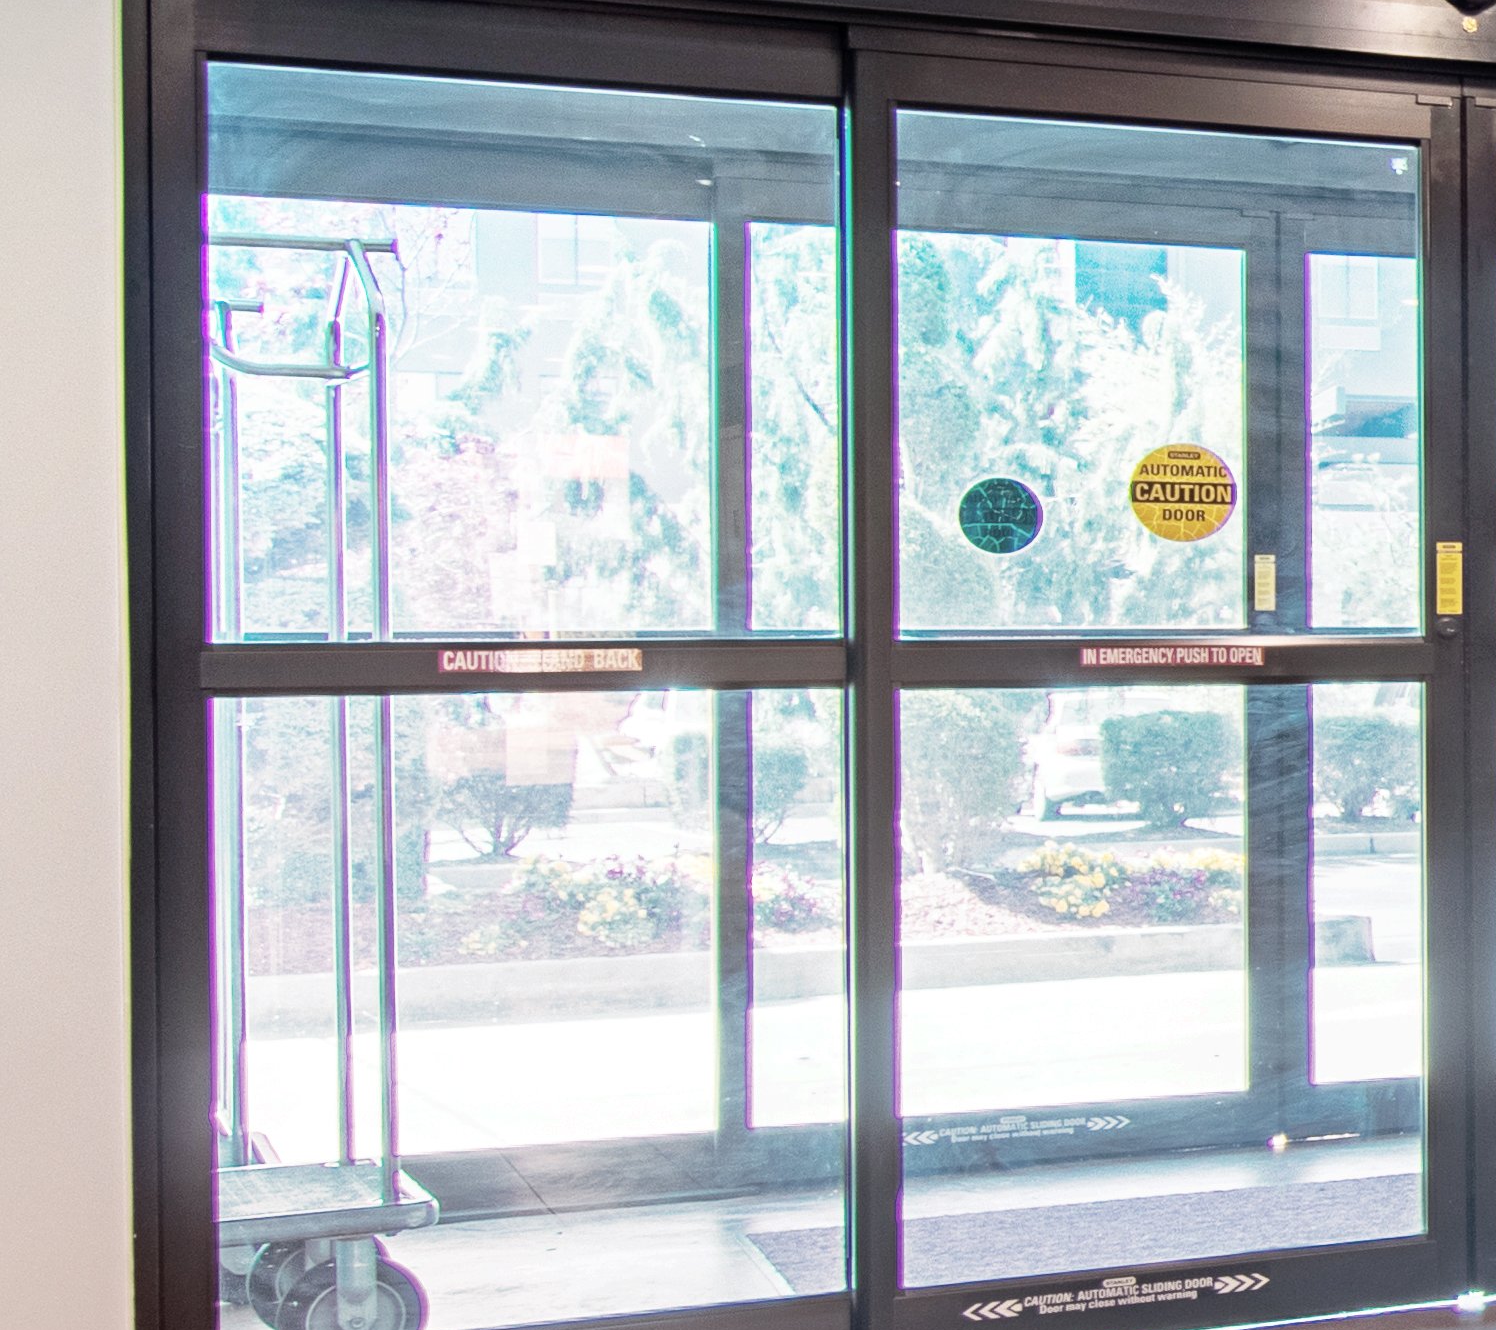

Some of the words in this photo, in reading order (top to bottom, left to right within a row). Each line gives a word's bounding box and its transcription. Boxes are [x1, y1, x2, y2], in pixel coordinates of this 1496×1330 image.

[1139, 464, 1228, 478] AUTOMATIC
[1135, 483, 1232, 502] CAUTION
[1163, 509, 1205, 521] DOOR
[593, 648, 640, 670] BACK
[1083, 648, 1097, 664] IN
[1099, 647, 1174, 664] EMERGENCY
[1176, 647, 1209, 663] PUSH
[1211, 647, 1227, 663] TO
[1229, 647, 1263, 665] OPEN
[1024, 1292, 1074, 1307] CAUTION:
[1078, 1284, 1139, 1301] AUTOMATIC
[1141, 1279, 1182, 1294] SLIDING
[1184, 1276, 1213, 1290] DOOR
[1039, 1304, 1064, 1314] Door
[1065, 1302, 1087, 1311] may
[1088, 1299, 1116, 1309] close
[1118, 1294, 1155, 1306] without
[1157, 1289, 1198, 1301] warning
